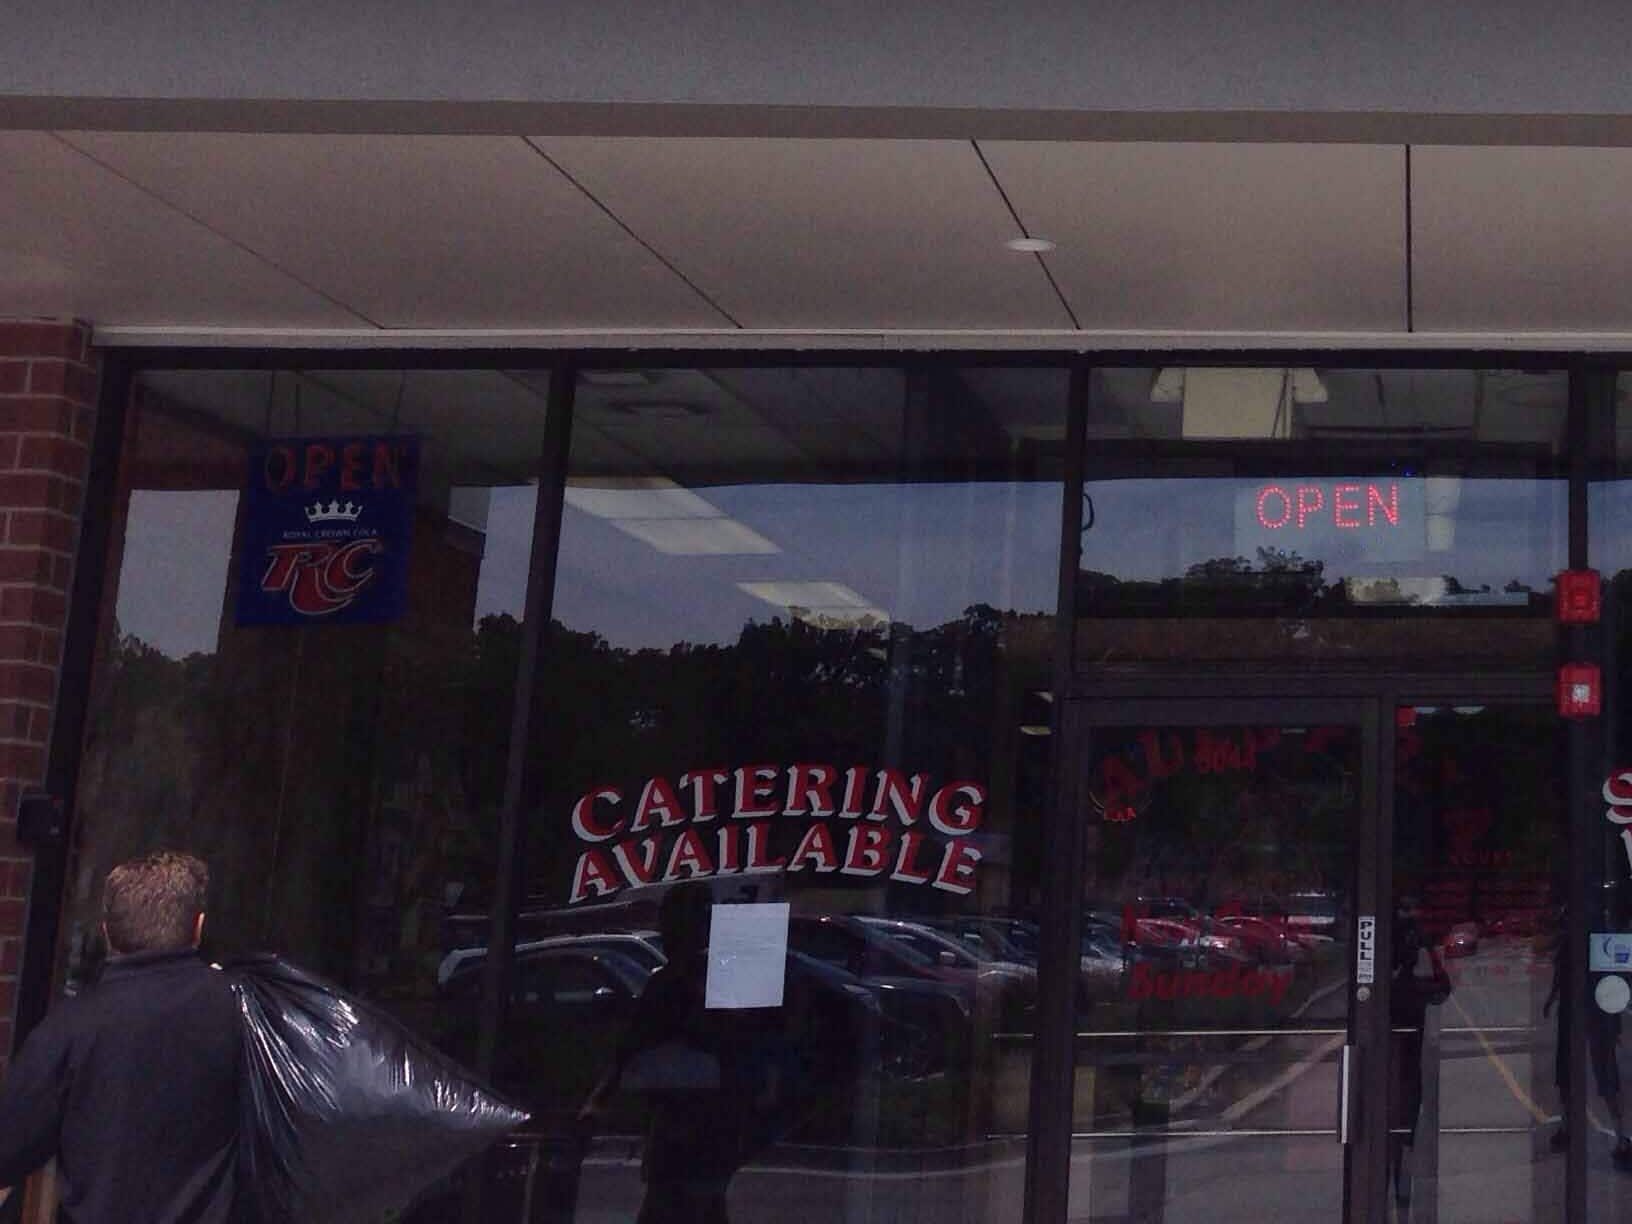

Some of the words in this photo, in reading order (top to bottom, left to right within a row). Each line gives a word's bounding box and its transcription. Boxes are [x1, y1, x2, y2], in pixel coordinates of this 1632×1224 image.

[264, 440, 402, 493] OPEN
[1257, 483, 1399, 528] OPEN
[261, 538, 383, 615] RC
[570, 762, 987, 843] CATERING
[568, 821, 984, 904] AVAILABLE
[1359, 920, 1374, 961] PULL
[1125, 963, 1295, 1005] Sunday
